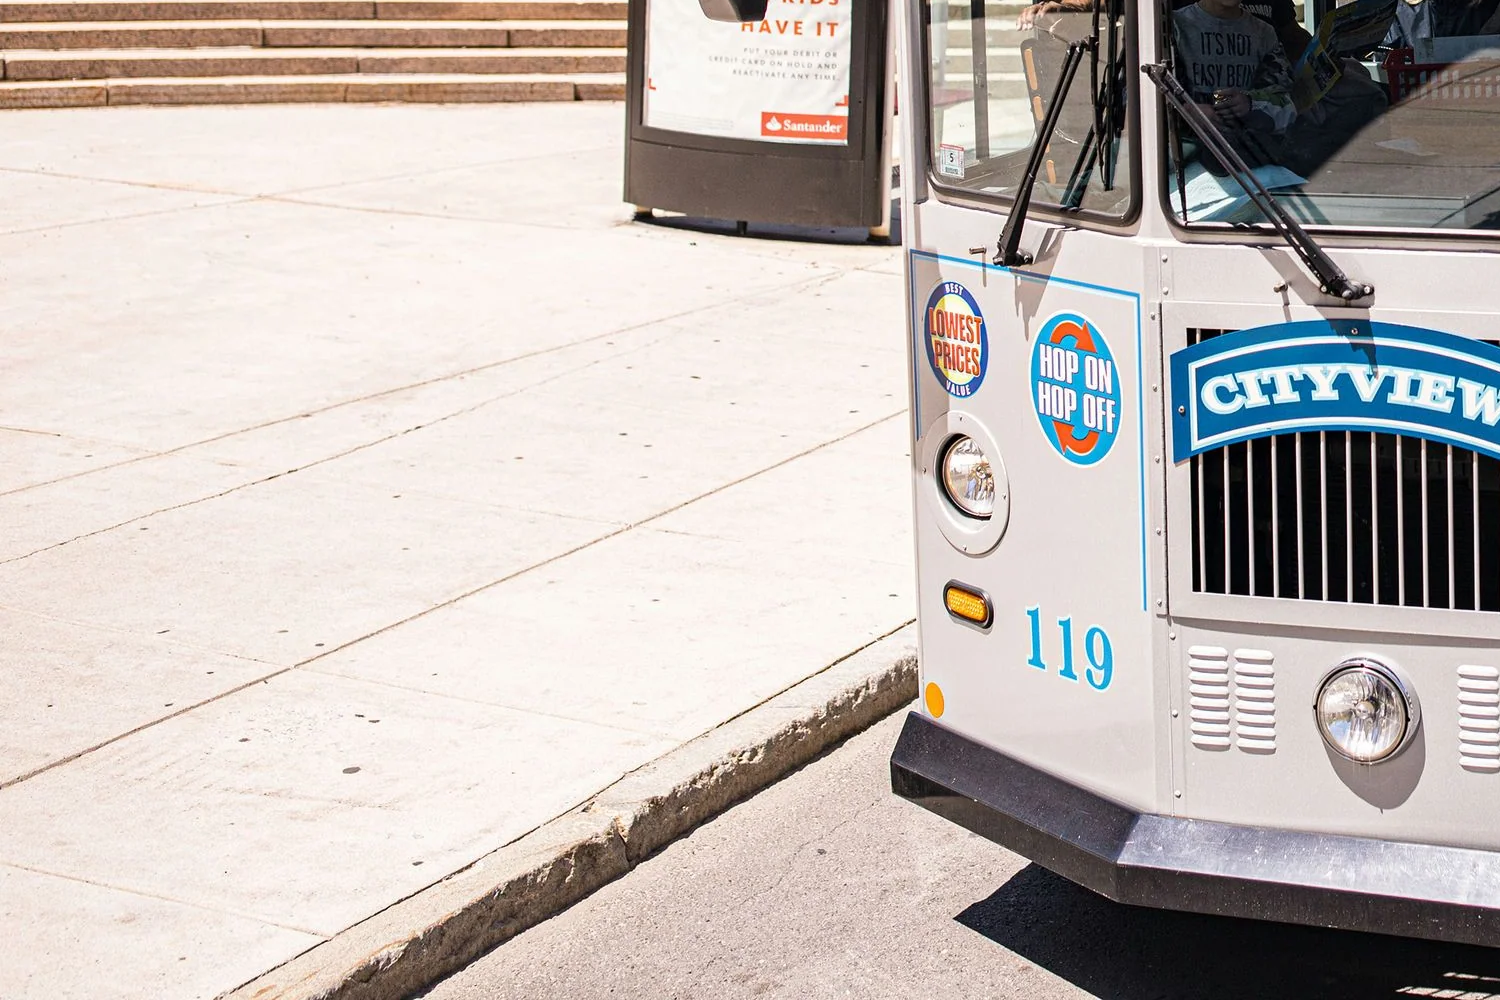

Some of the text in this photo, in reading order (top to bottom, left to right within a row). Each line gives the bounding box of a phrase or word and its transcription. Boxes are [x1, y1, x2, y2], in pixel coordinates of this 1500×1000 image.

[741, 19, 839, 37] HAVE IT
[764, 48, 788, 56] YOUR
[793, 50, 820, 58] DEBIT
[1200, 31, 1252, 56] IT'S NOT
[708, 55, 738, 63] CREDIT
[742, 58, 766, 66] CARD
[787, 61, 813, 69] HOLD
[732, 68, 786, 79] REACTIVATE
[1192, 62, 1255, 88] EASY BEIN
[783, 118, 843, 133] Santander
[944, 283, 964, 296] BEST
[928, 307, 982, 345] LOWEST
[934, 339, 981, 378] PRICES
[1039, 343, 1112, 395] HOP ON
[946, 380, 971, 396] VALUE
[1037, 380, 1116, 434] HOP OFF
[1025, 602, 1115, 693] 119
